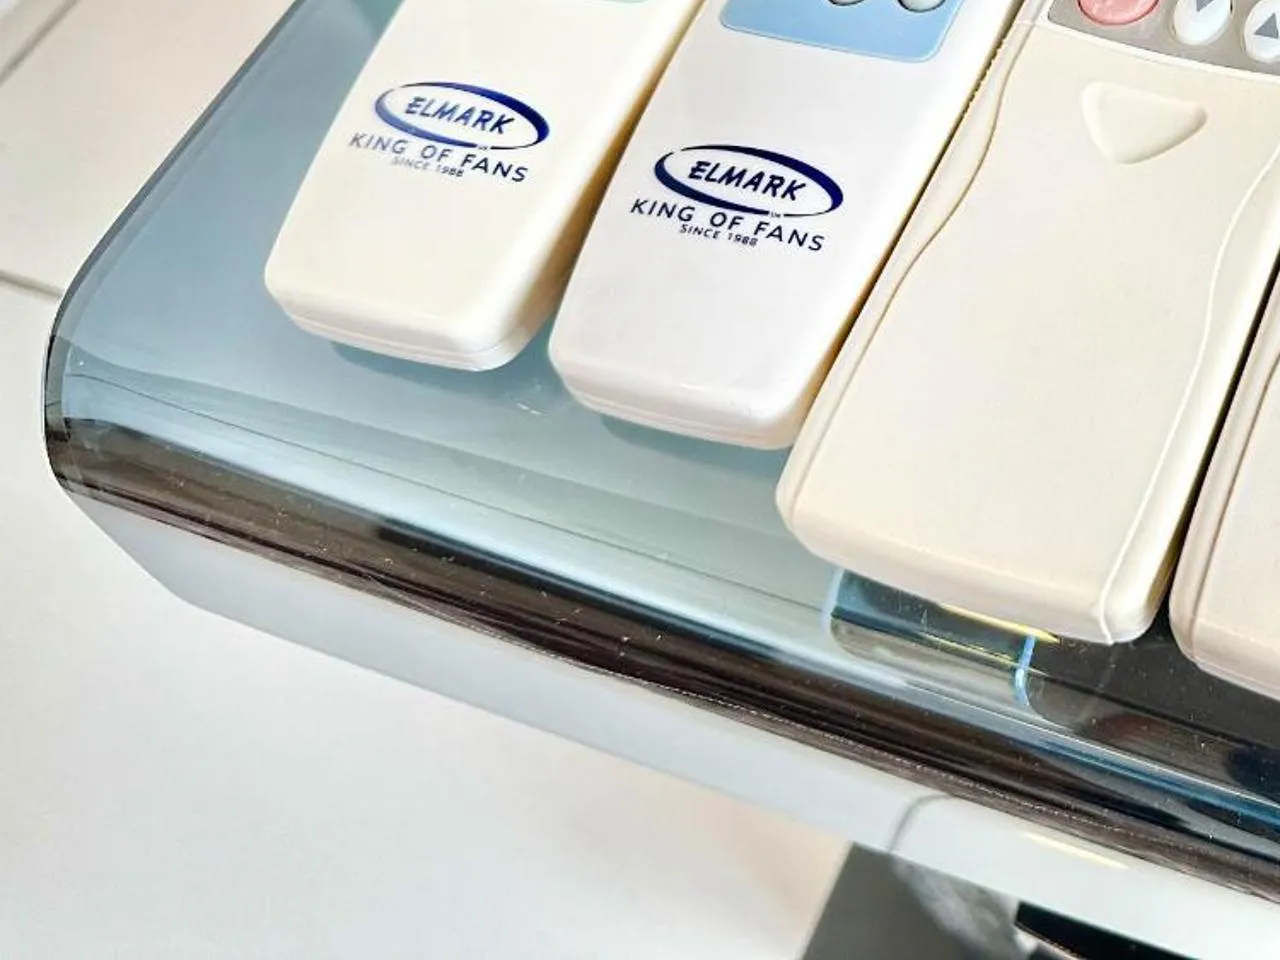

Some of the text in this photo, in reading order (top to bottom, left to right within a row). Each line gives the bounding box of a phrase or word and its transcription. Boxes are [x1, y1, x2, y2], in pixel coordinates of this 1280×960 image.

[404, 96, 516, 135] ELMARK
[348, 132, 529, 183] KING OF FANS
[391, 155, 430, 172] SINCE
[687, 160, 807, 201] ELMARK
[629, 198, 825, 252] KING OF FANS
[679, 223, 760, 247] SINCE 1988
